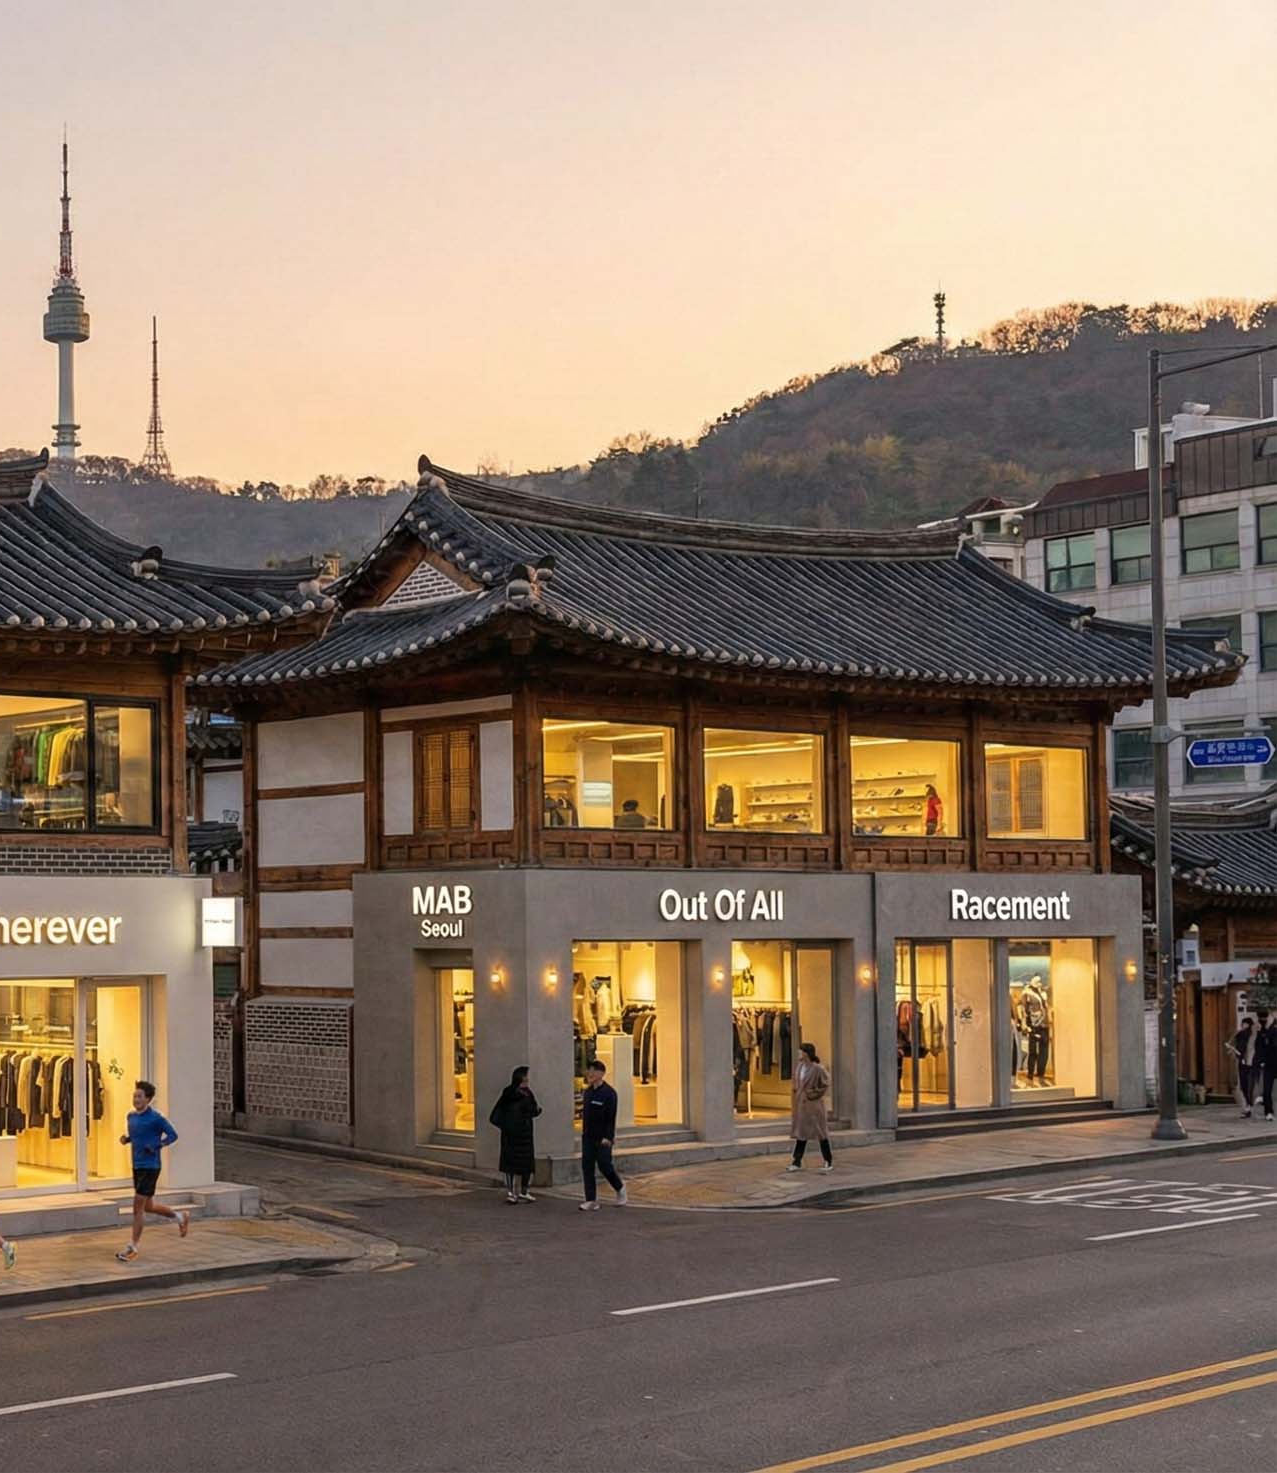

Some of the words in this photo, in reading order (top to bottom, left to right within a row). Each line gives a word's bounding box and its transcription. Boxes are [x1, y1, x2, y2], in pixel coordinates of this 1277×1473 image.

[412, 885, 473, 915] MAB
[660, 888, 709, 921] Out
[714, 888, 746, 921] Of
[750, 890, 785, 921] All
[951, 888, 1072, 921] Racement
[420, 918, 464, 938] Seoul
